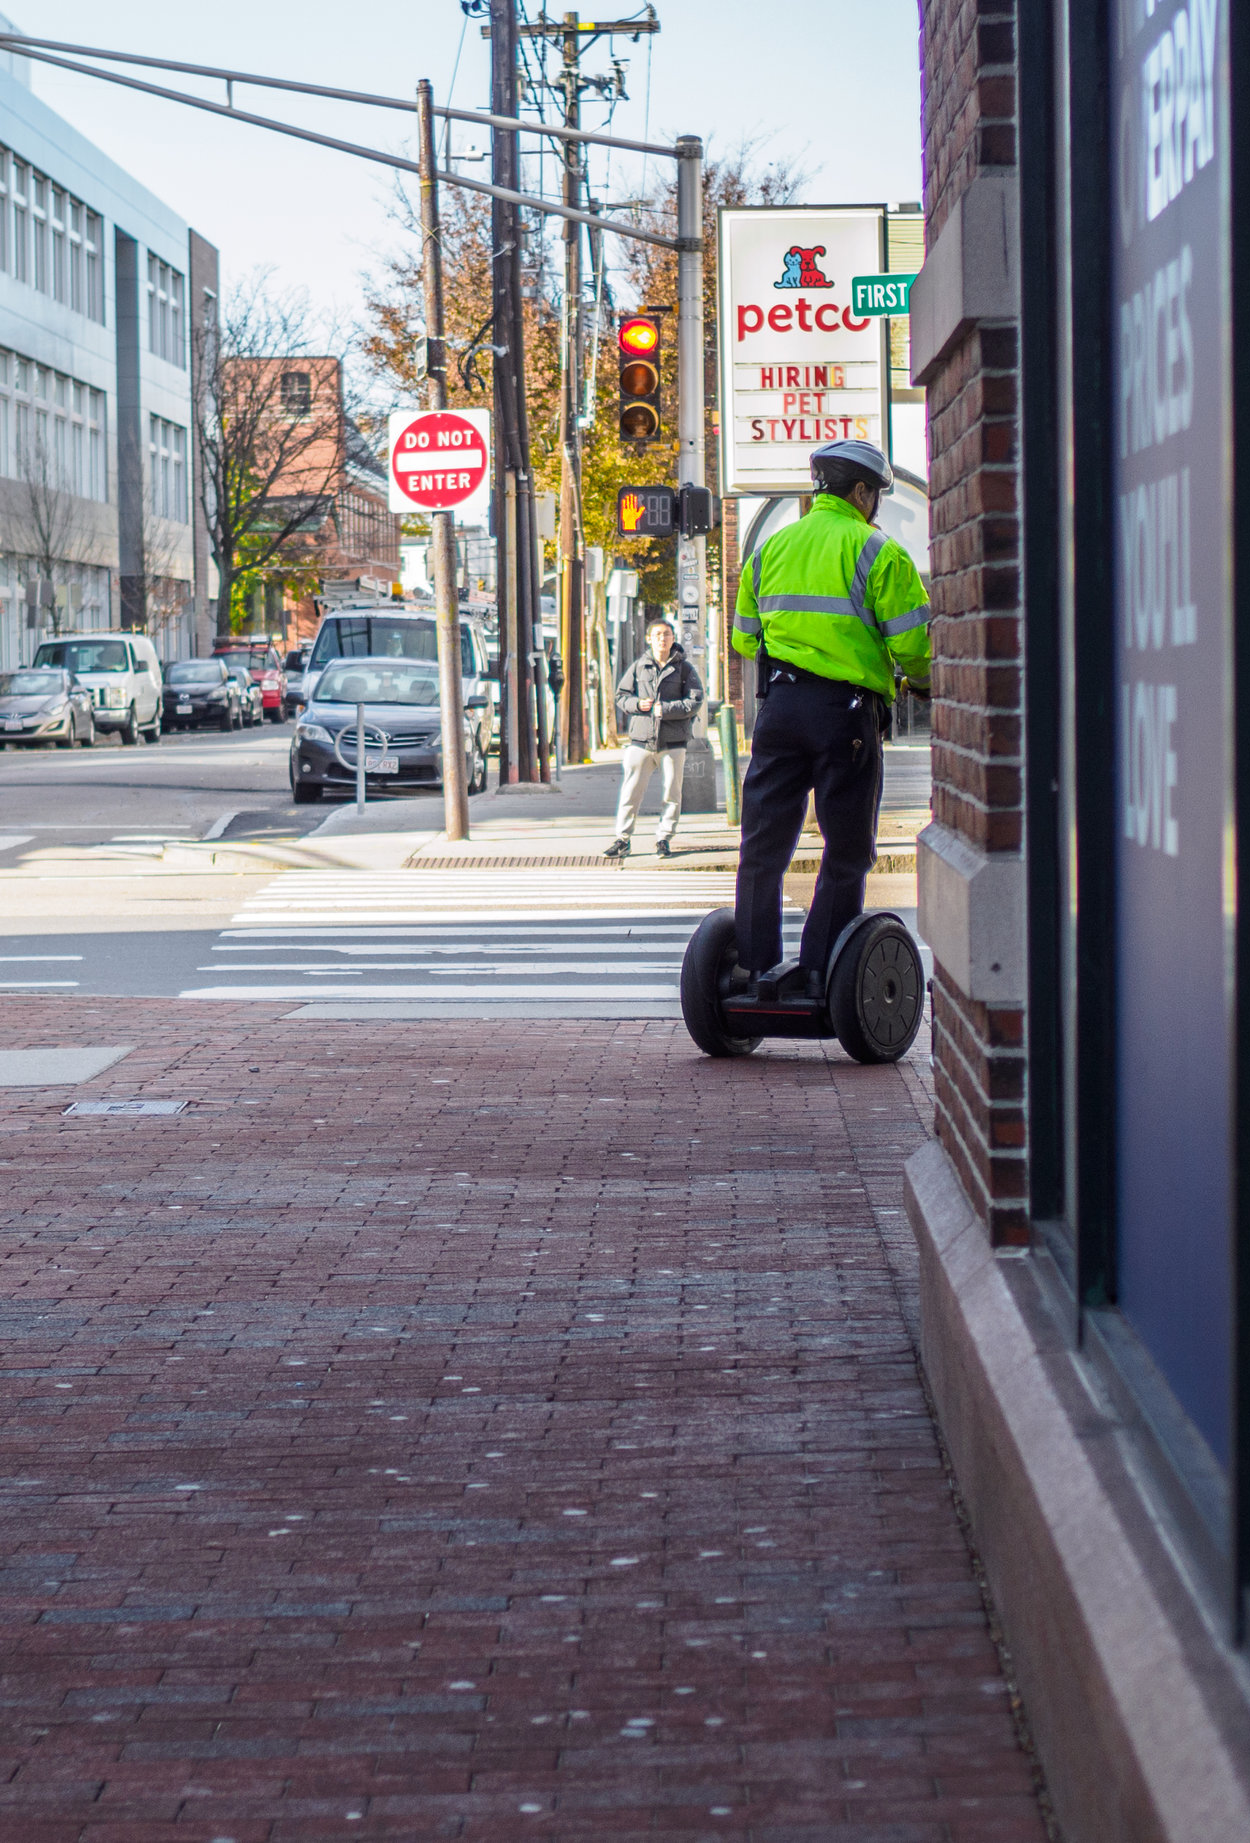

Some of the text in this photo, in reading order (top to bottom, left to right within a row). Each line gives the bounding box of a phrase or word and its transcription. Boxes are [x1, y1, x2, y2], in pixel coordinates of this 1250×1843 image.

[857, 283, 908, 308] FIRST
[1120, 243, 1194, 460] PRICES
[761, 366, 845, 388] HIRING
[783, 393, 826, 414] PET
[405, 430, 474, 448] DO NOT
[752, 418, 868, 441] STYLISTS
[408, 473, 471, 492] ENTER
[1121, 680, 1179, 857] LOVE
